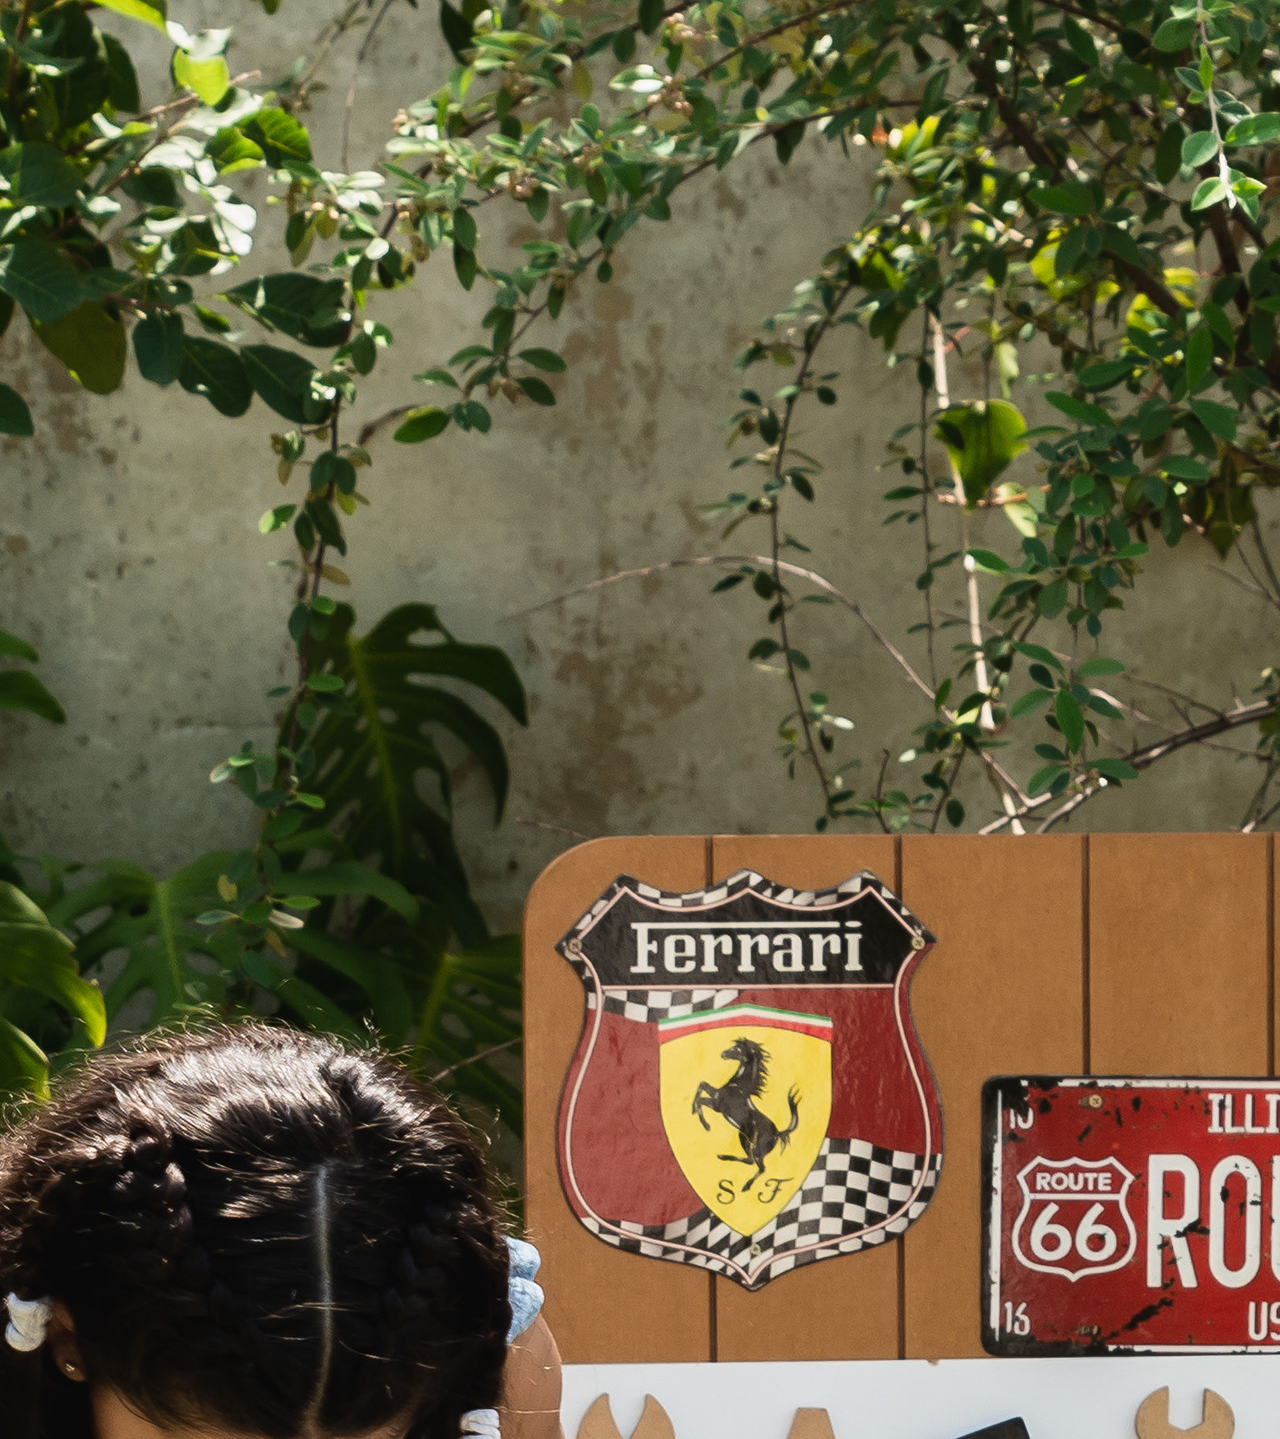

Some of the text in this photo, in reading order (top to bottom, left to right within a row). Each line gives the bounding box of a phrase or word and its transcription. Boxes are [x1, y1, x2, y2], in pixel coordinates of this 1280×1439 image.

[630, 921, 864, 974] Ferrari
[1035, 1171, 1113, 1193] ROUTE
[1029, 1202, 1118, 1262] 66
[1004, 1301, 1031, 1336] 16
